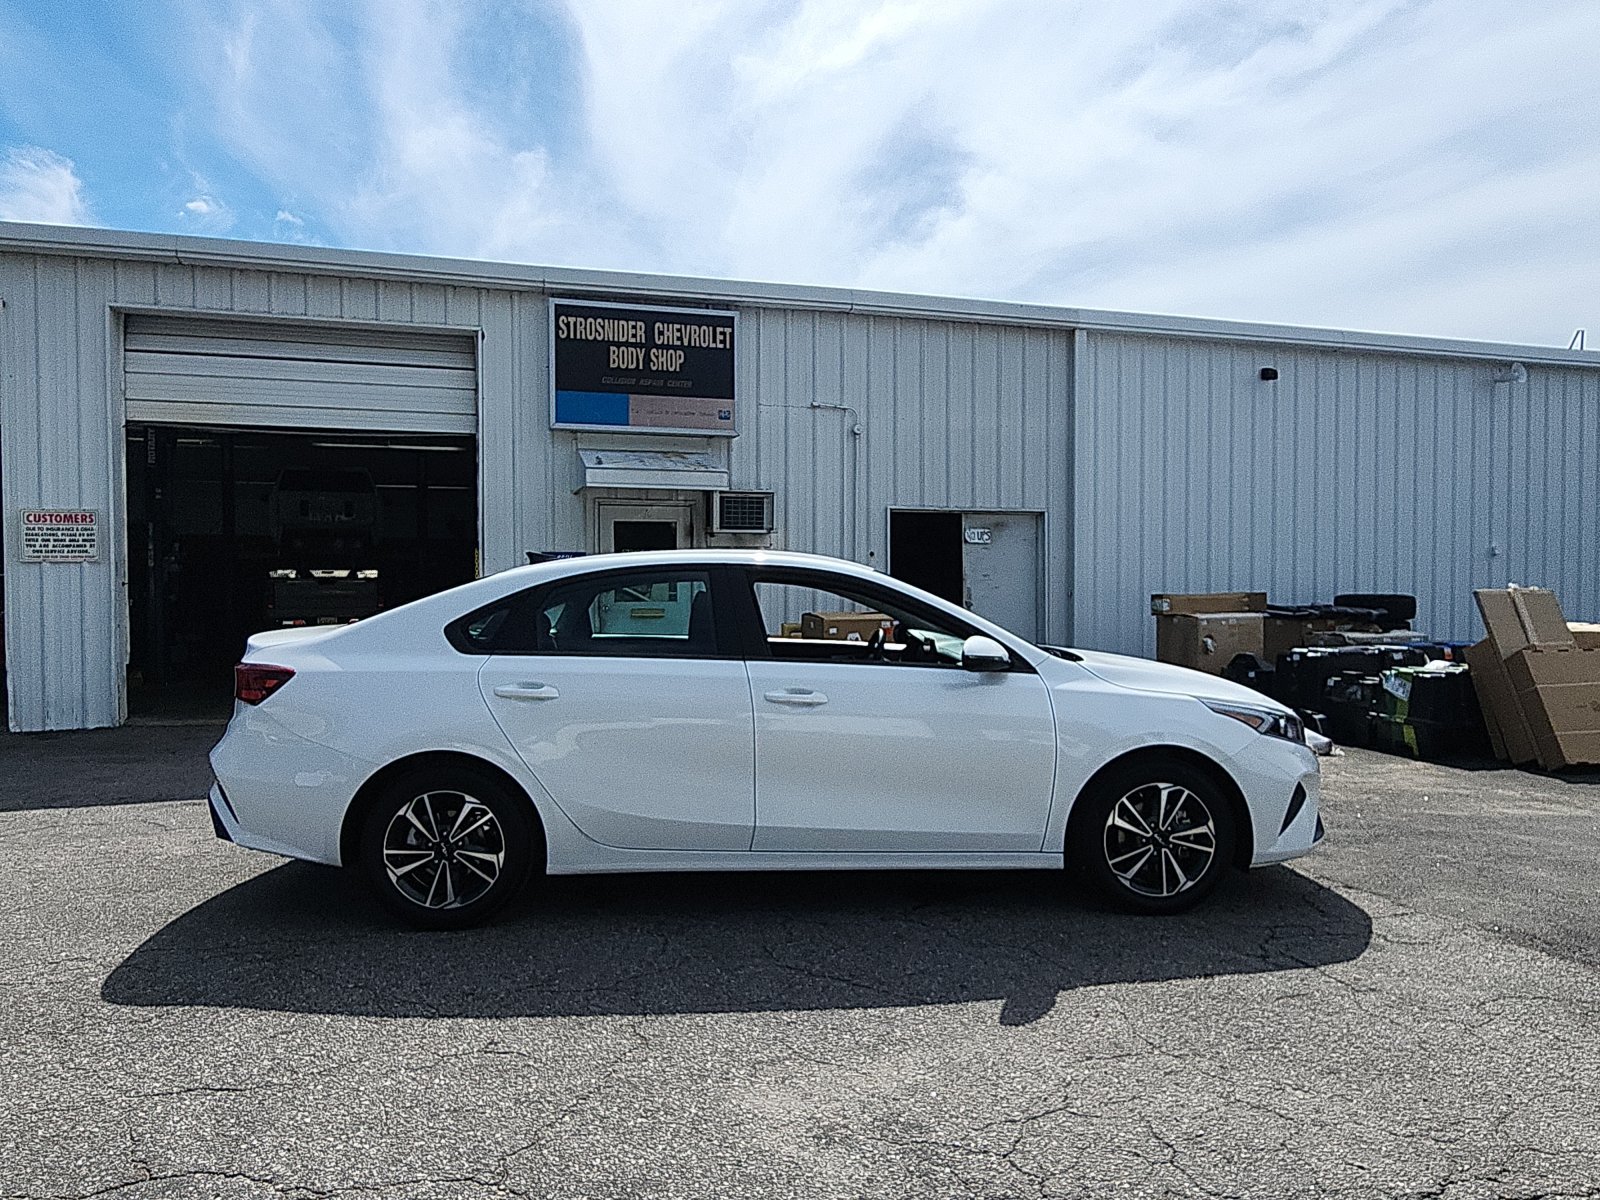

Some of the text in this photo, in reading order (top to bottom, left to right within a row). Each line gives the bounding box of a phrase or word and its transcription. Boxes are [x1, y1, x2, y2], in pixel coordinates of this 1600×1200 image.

[559, 316, 732, 349] STROSNIDER CHEVROLET
[609, 346, 684, 371] BODY SHOP
[602, 376, 693, 388] COLLISION REPAIR CENTER
[26, 513, 94, 524] CUSTOMERS
